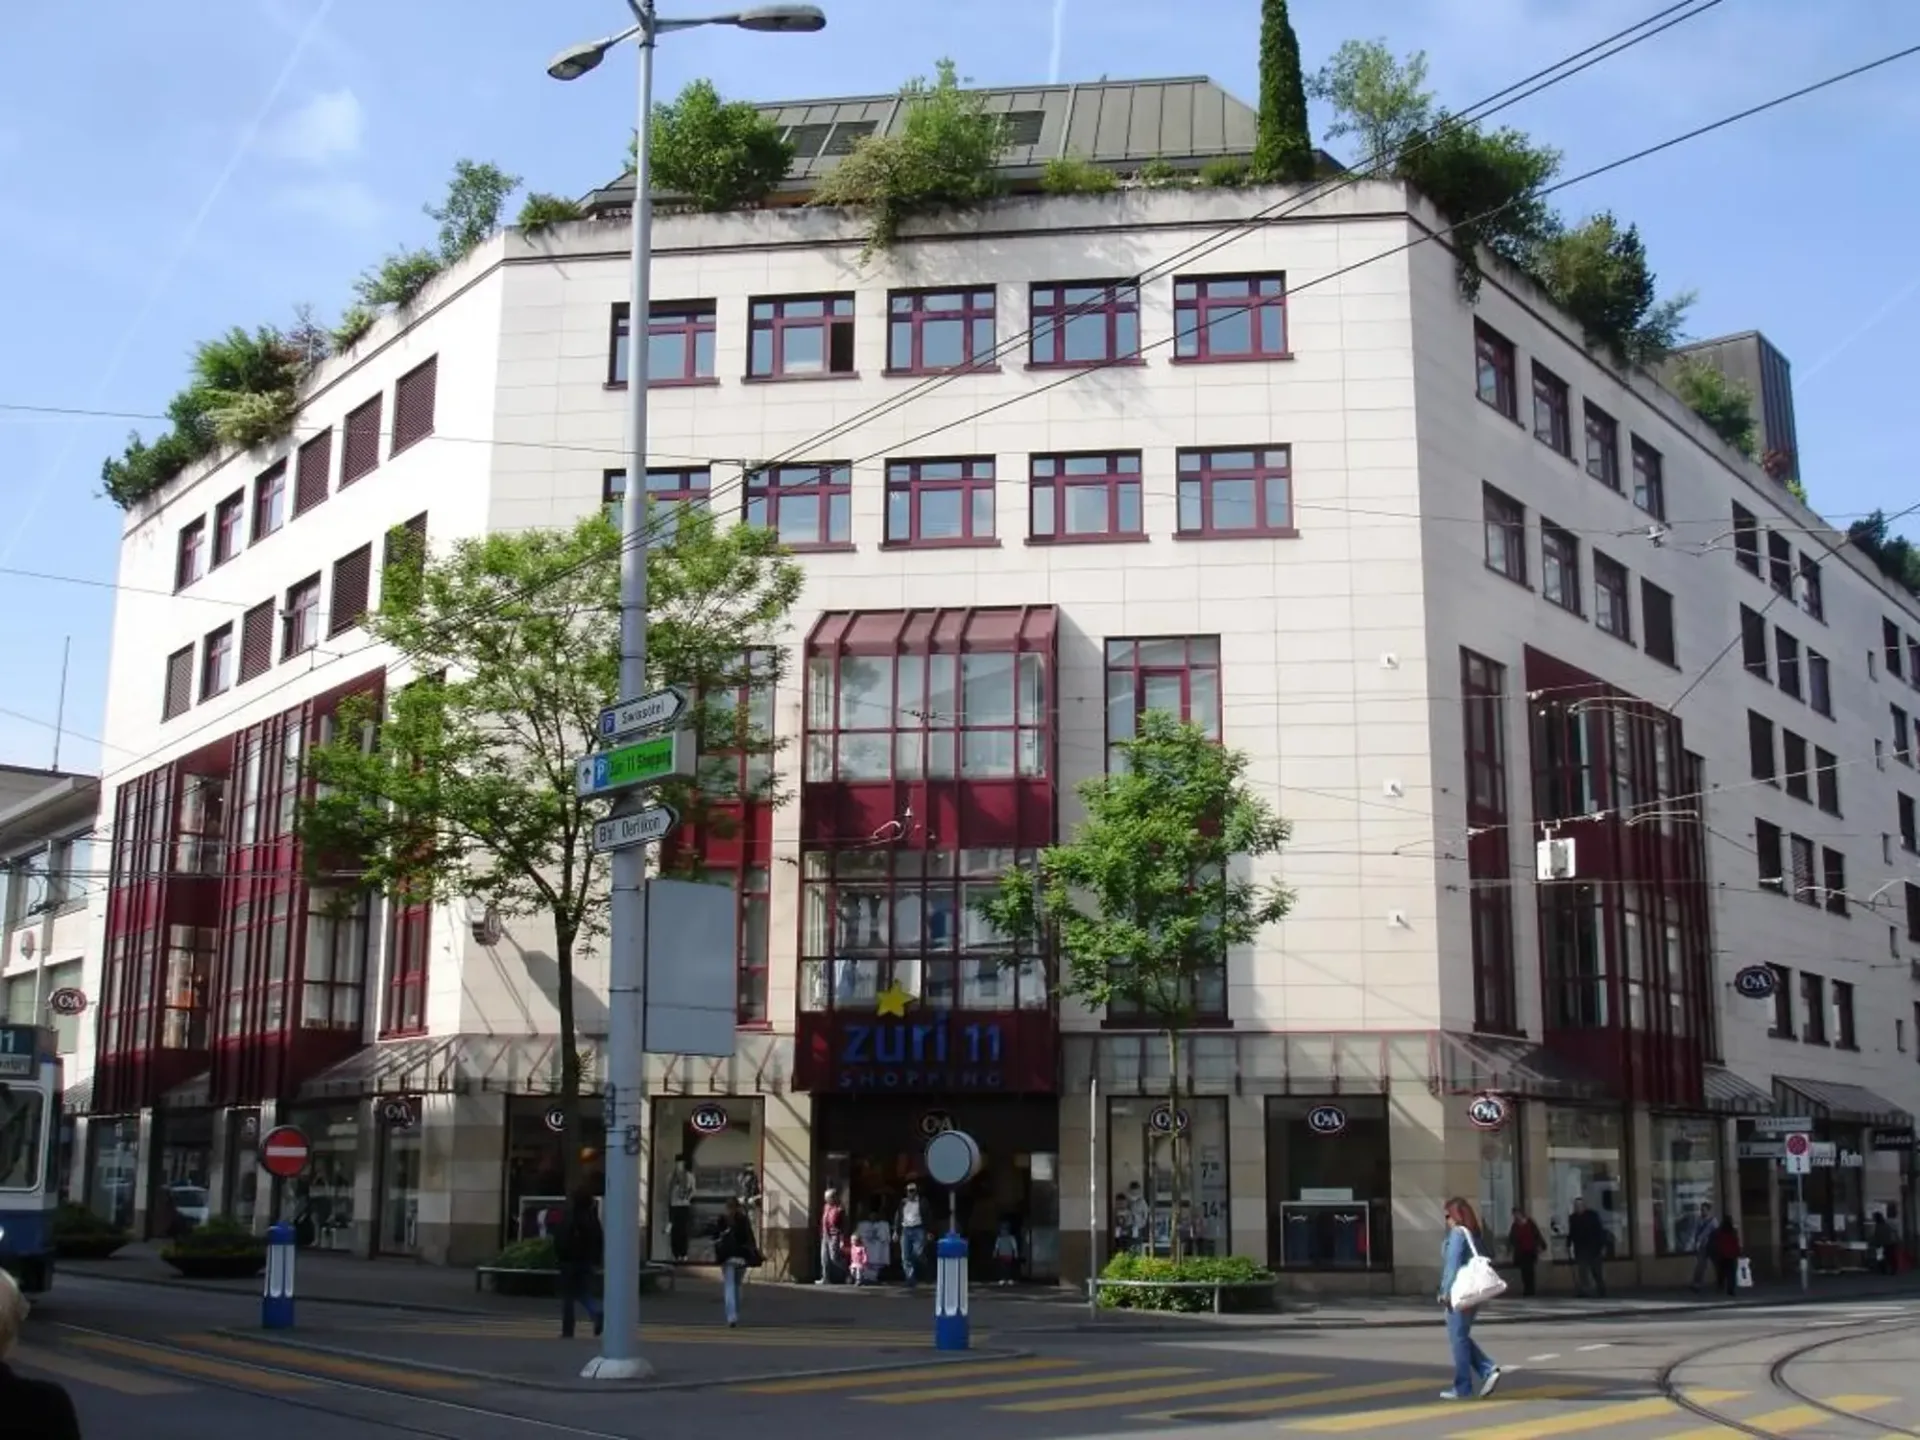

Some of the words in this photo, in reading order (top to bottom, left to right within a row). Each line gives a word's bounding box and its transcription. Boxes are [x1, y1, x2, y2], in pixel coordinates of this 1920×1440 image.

[964, 1023, 1003, 1062] 11
[839, 1071, 1002, 1088] SHOPPING
[696, 1111, 720, 1127] C&A
[1313, 1111, 1340, 1128] C&A
[1474, 1103, 1499, 1119] C&A
